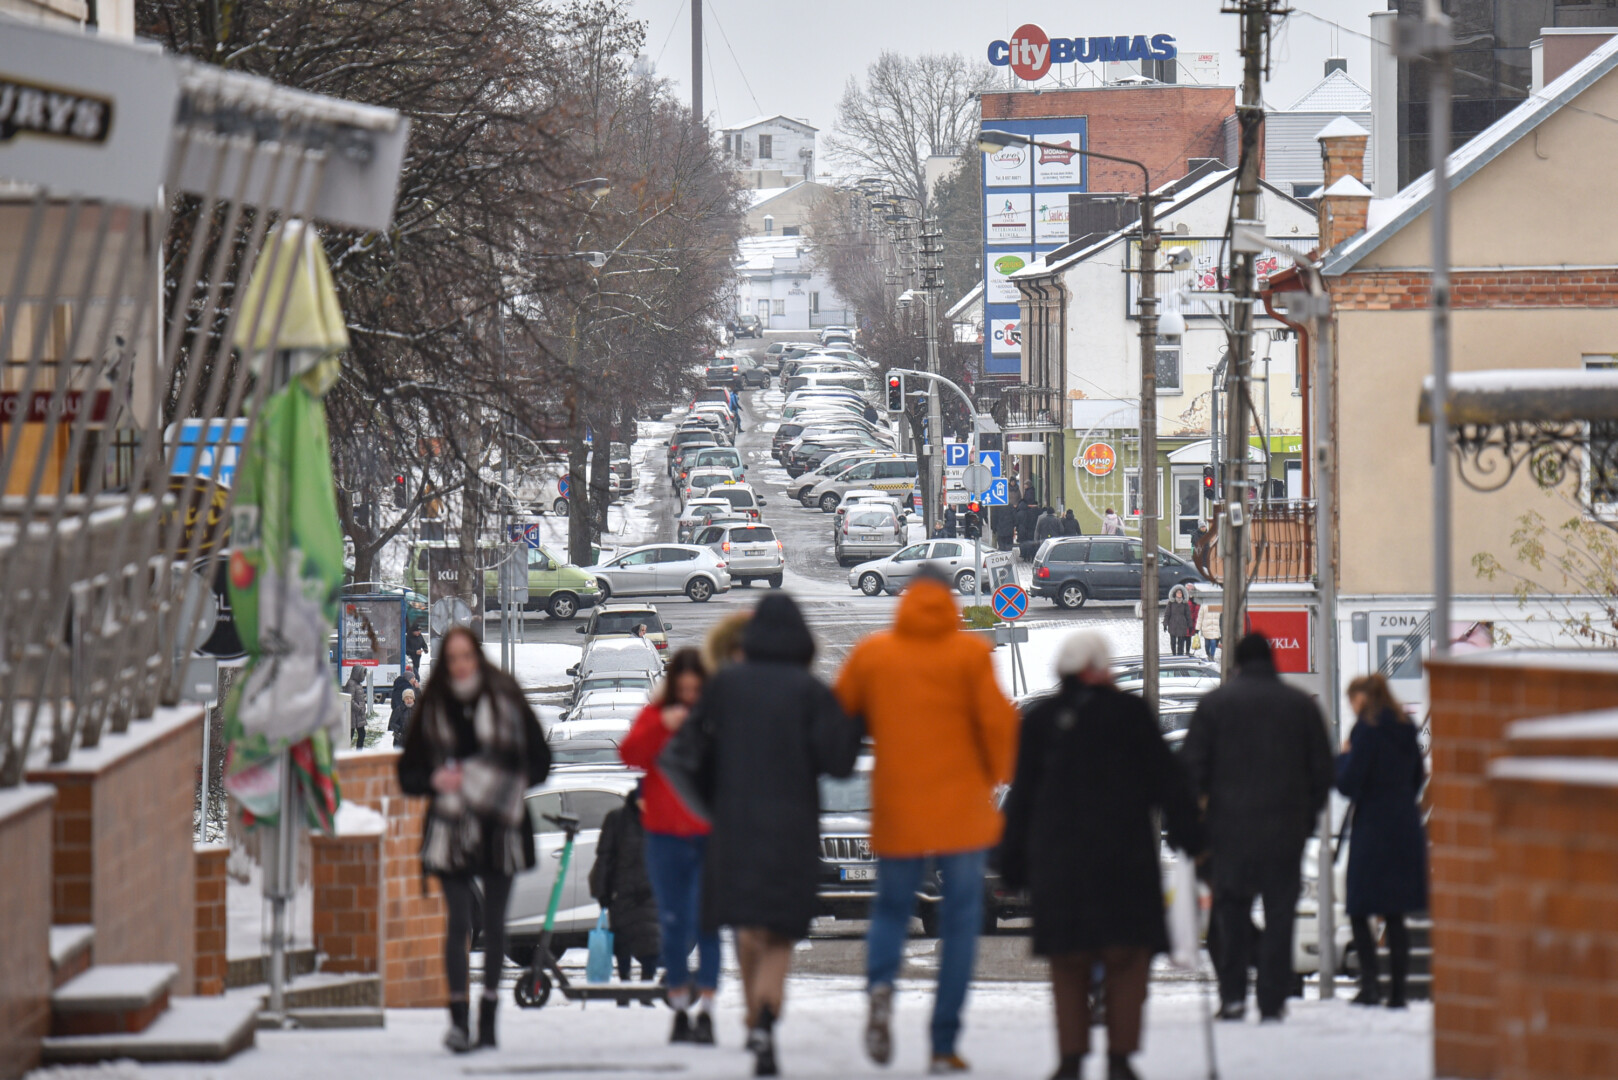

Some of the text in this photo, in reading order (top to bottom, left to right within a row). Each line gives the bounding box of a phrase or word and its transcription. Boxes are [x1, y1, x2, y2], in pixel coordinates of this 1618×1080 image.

[951, 446, 965, 464] P
[991, 555, 1009, 564] ZONA
[1380, 616, 1418, 627] ZONA
